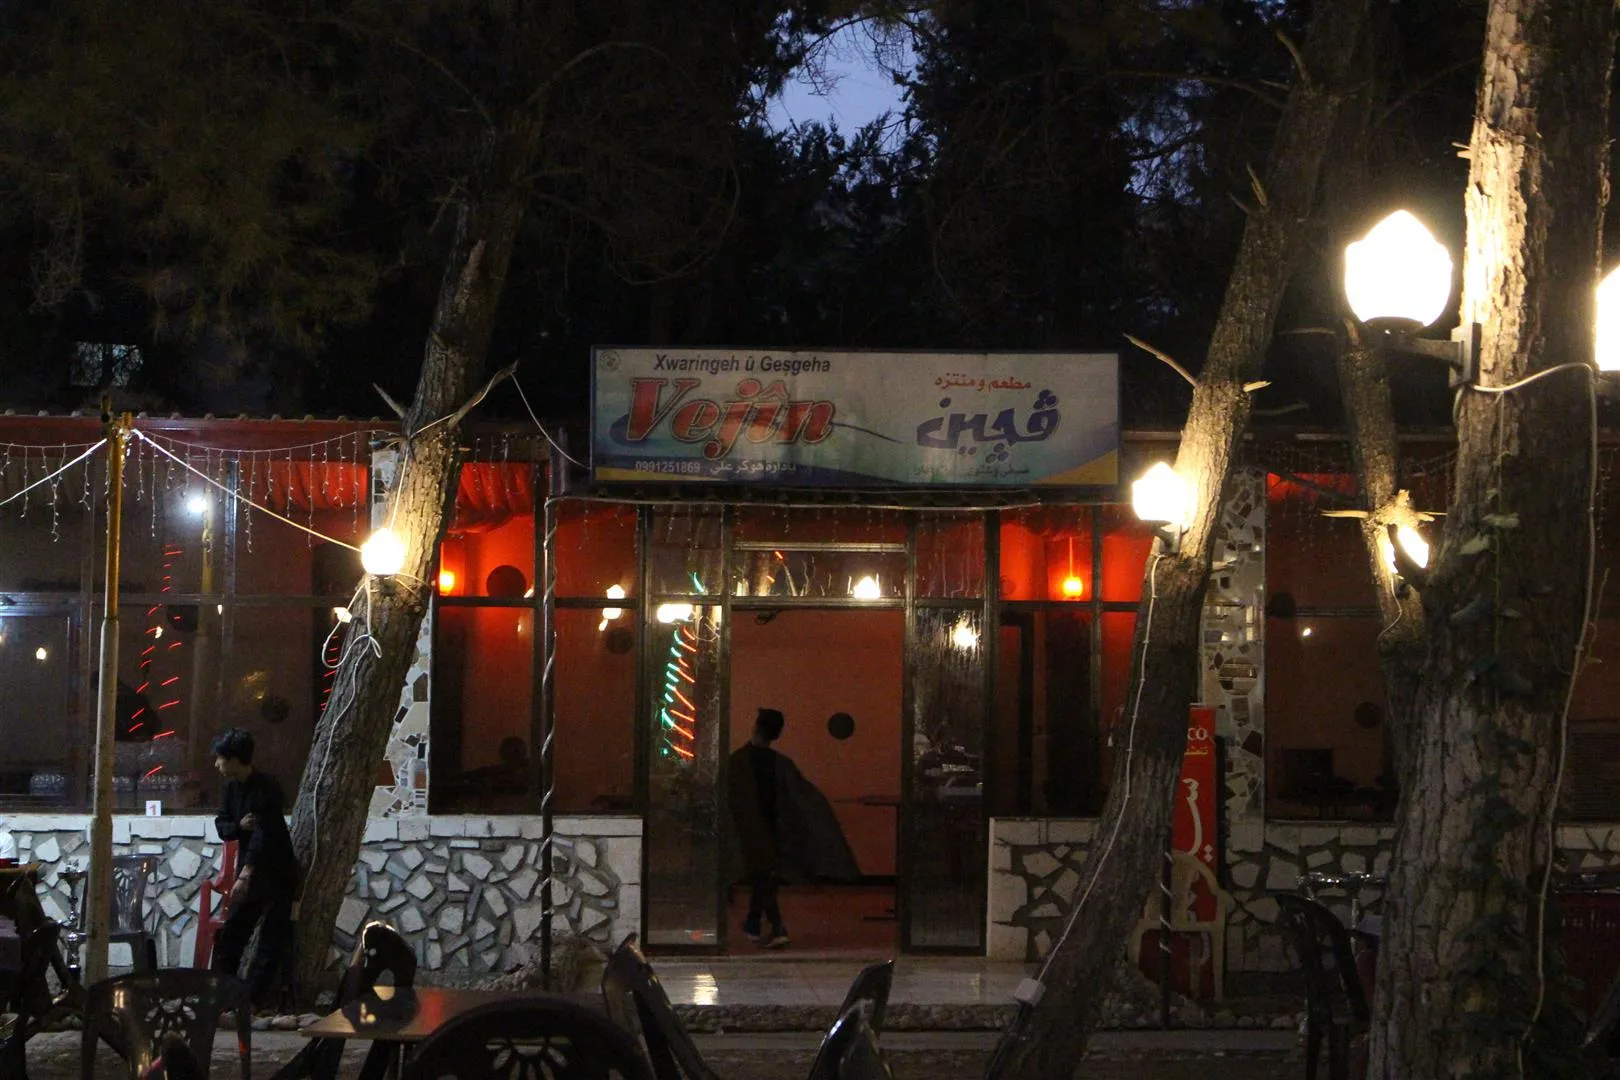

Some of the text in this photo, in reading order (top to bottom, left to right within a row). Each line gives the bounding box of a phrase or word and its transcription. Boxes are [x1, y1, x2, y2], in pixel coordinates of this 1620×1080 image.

[654, 354, 740, 375] Xwaringeh
[988, 376, 1031, 392] مطعم
[625, 377, 836, 461] Vejîn
